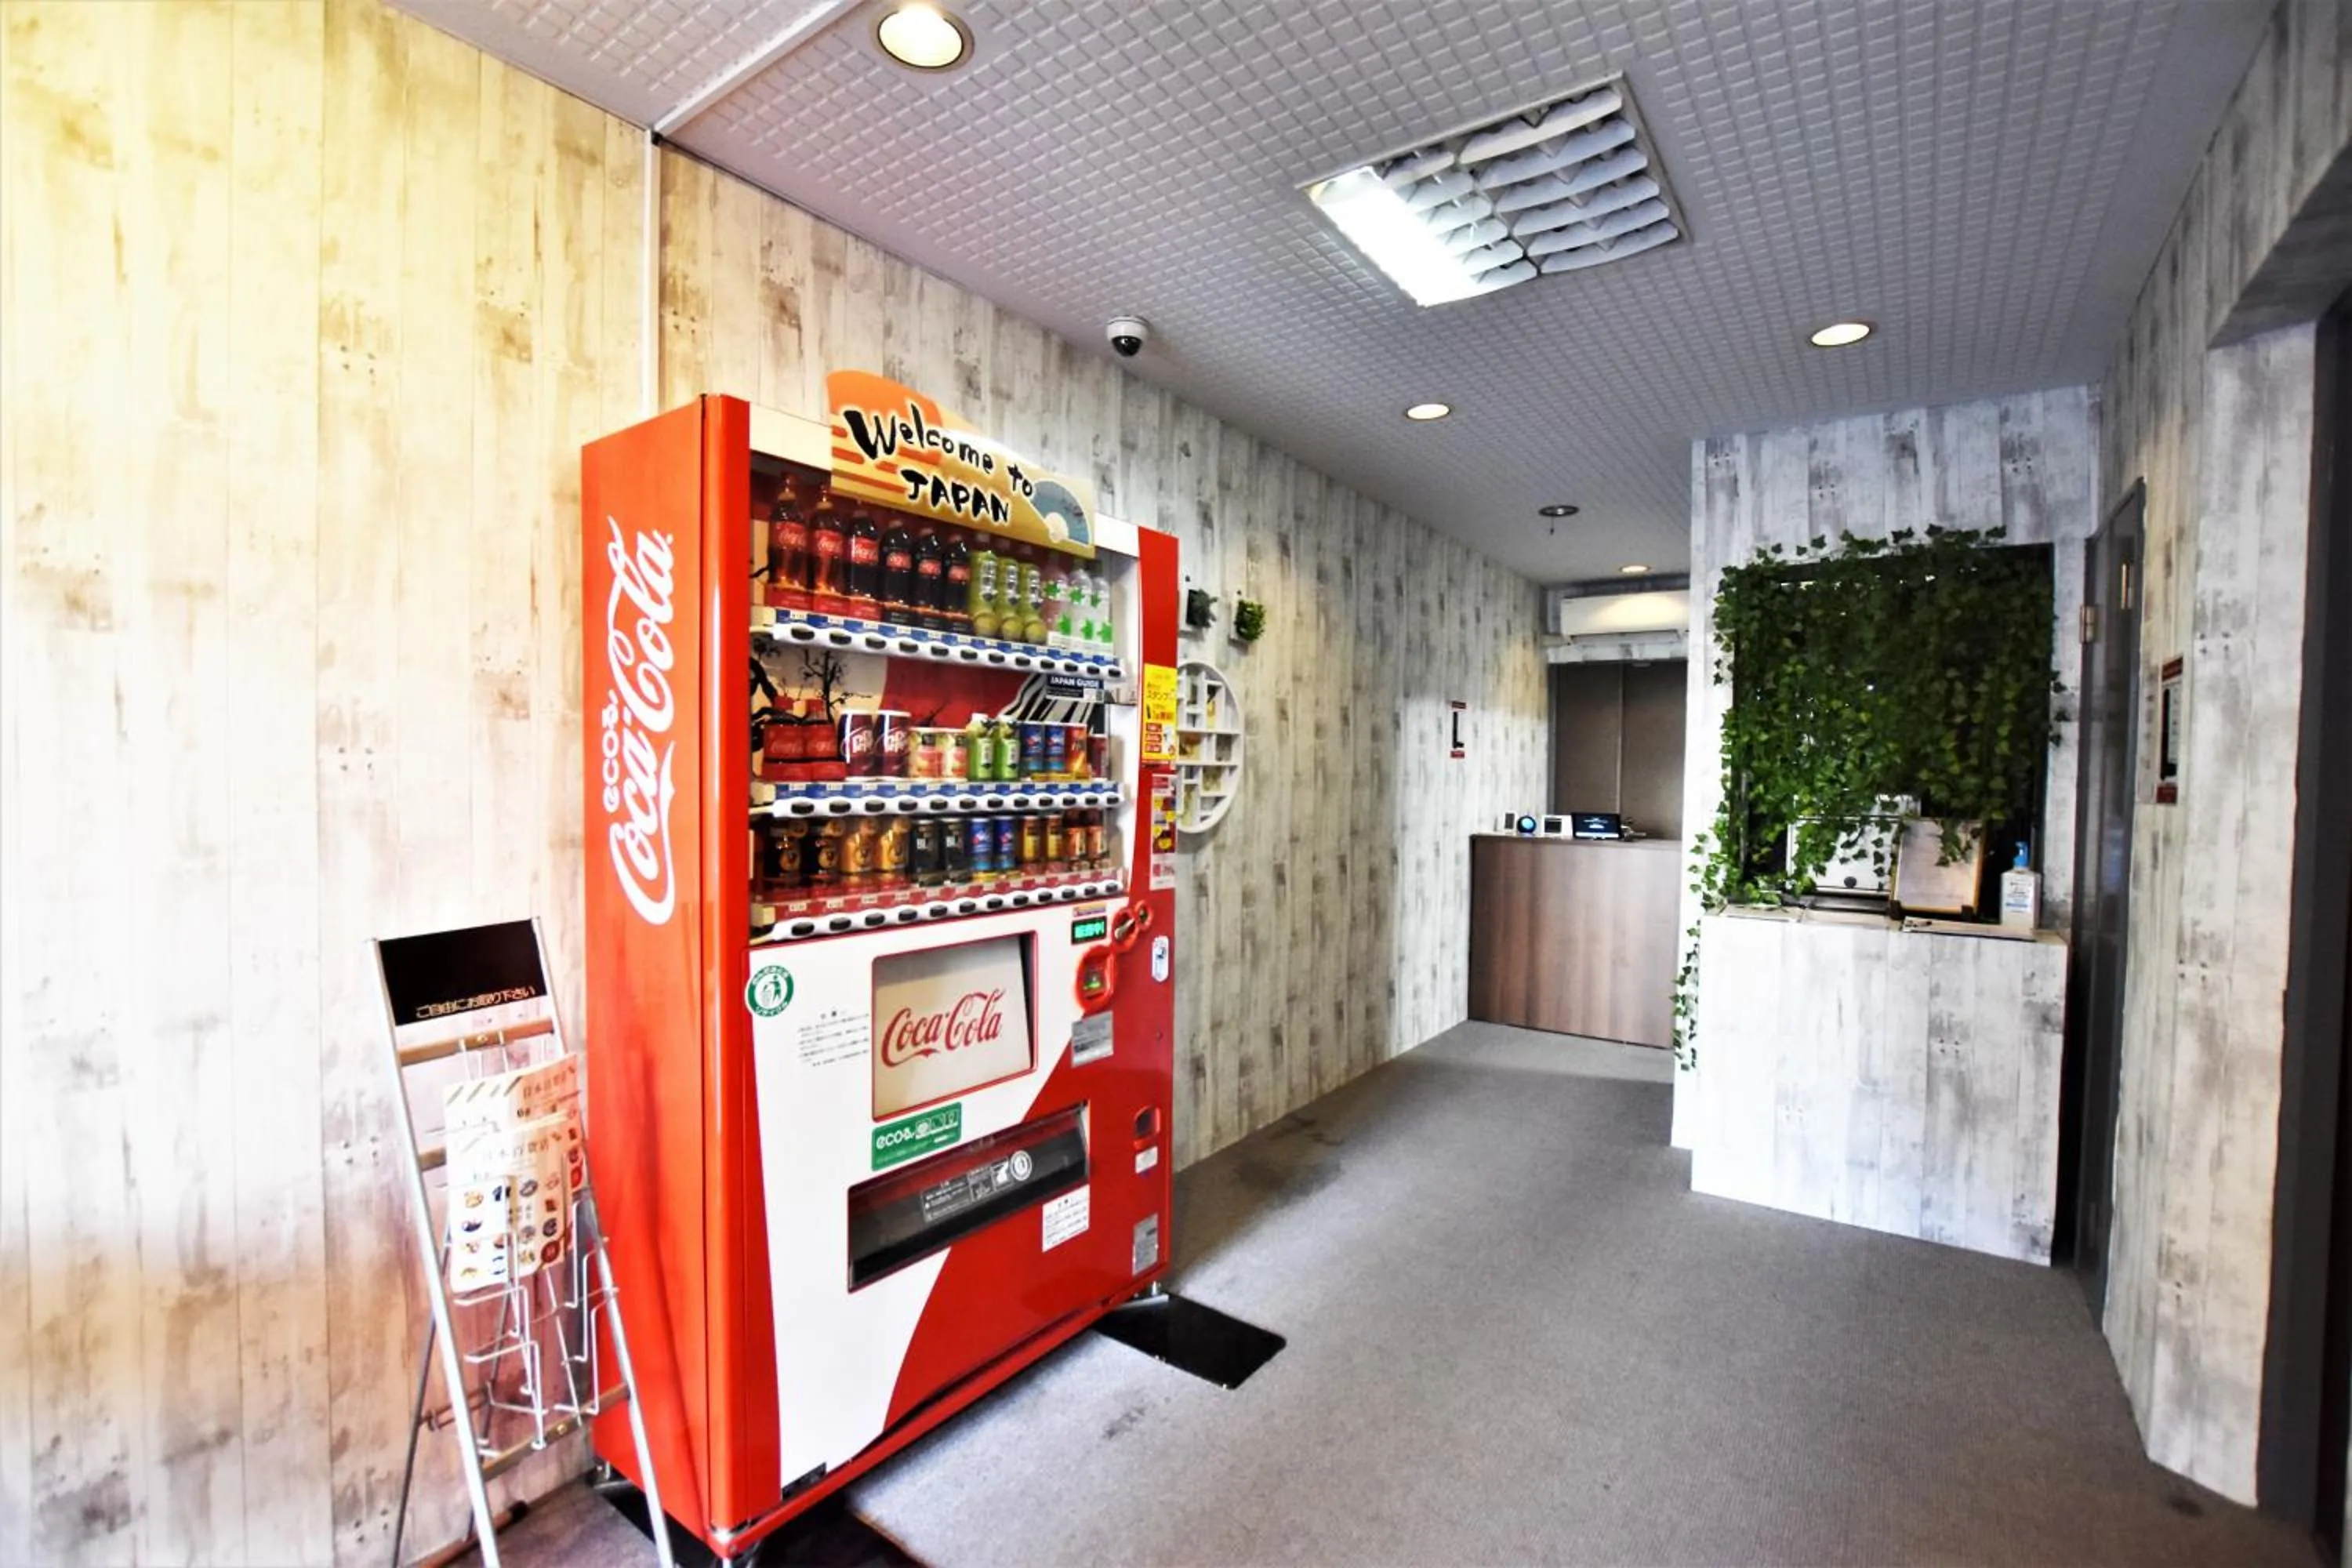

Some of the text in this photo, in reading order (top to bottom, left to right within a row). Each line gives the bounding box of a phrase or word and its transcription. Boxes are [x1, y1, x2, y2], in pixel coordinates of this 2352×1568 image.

[843, 403, 1033, 497] Welcome to
[901, 470, 1009, 523] JAPAN
[1051, 677, 1075, 686] JAPAN
[608, 514, 676, 925] Coca-Cola
[416, 985, 536, 1019] ご自由にお取り下さい
[880, 988, 1006, 1068] Coca-Cola
